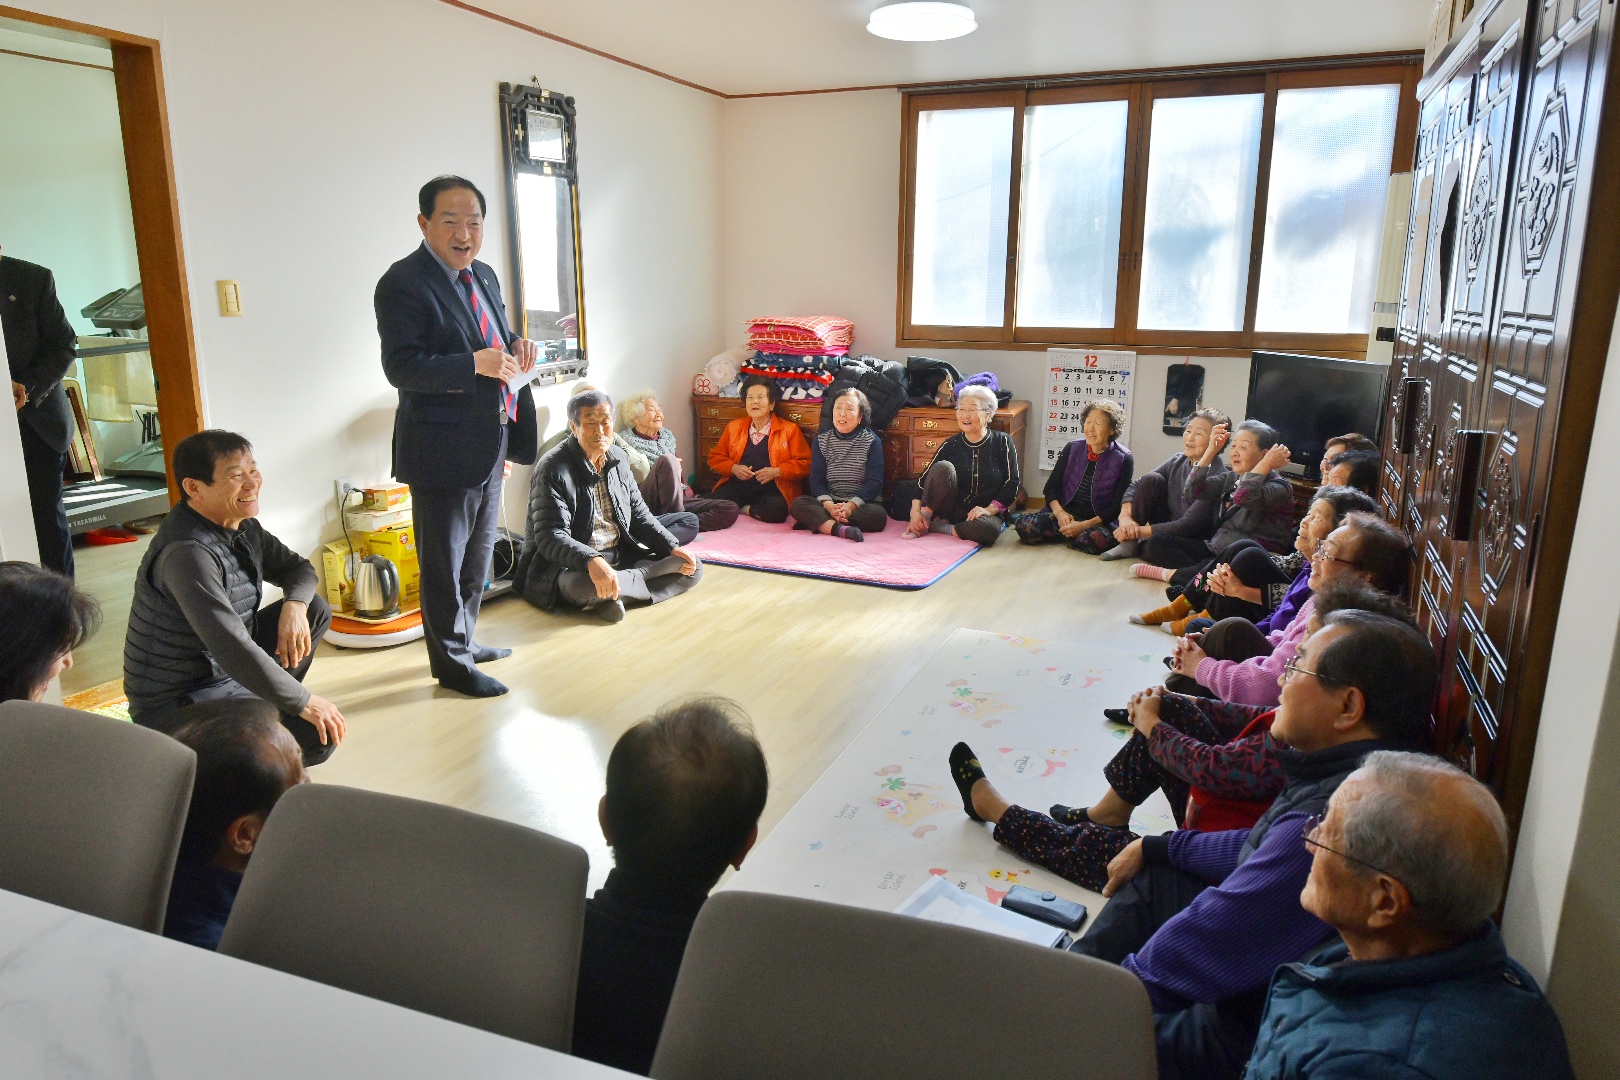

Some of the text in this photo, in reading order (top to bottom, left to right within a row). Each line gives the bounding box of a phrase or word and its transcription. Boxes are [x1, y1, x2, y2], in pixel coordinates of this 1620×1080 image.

[1084, 354, 1098, 368] 12
[1121, 375, 1126, 383] 7
[1060, 412, 1069, 420] 23
[73, 514, 106, 527] TREADMILL
